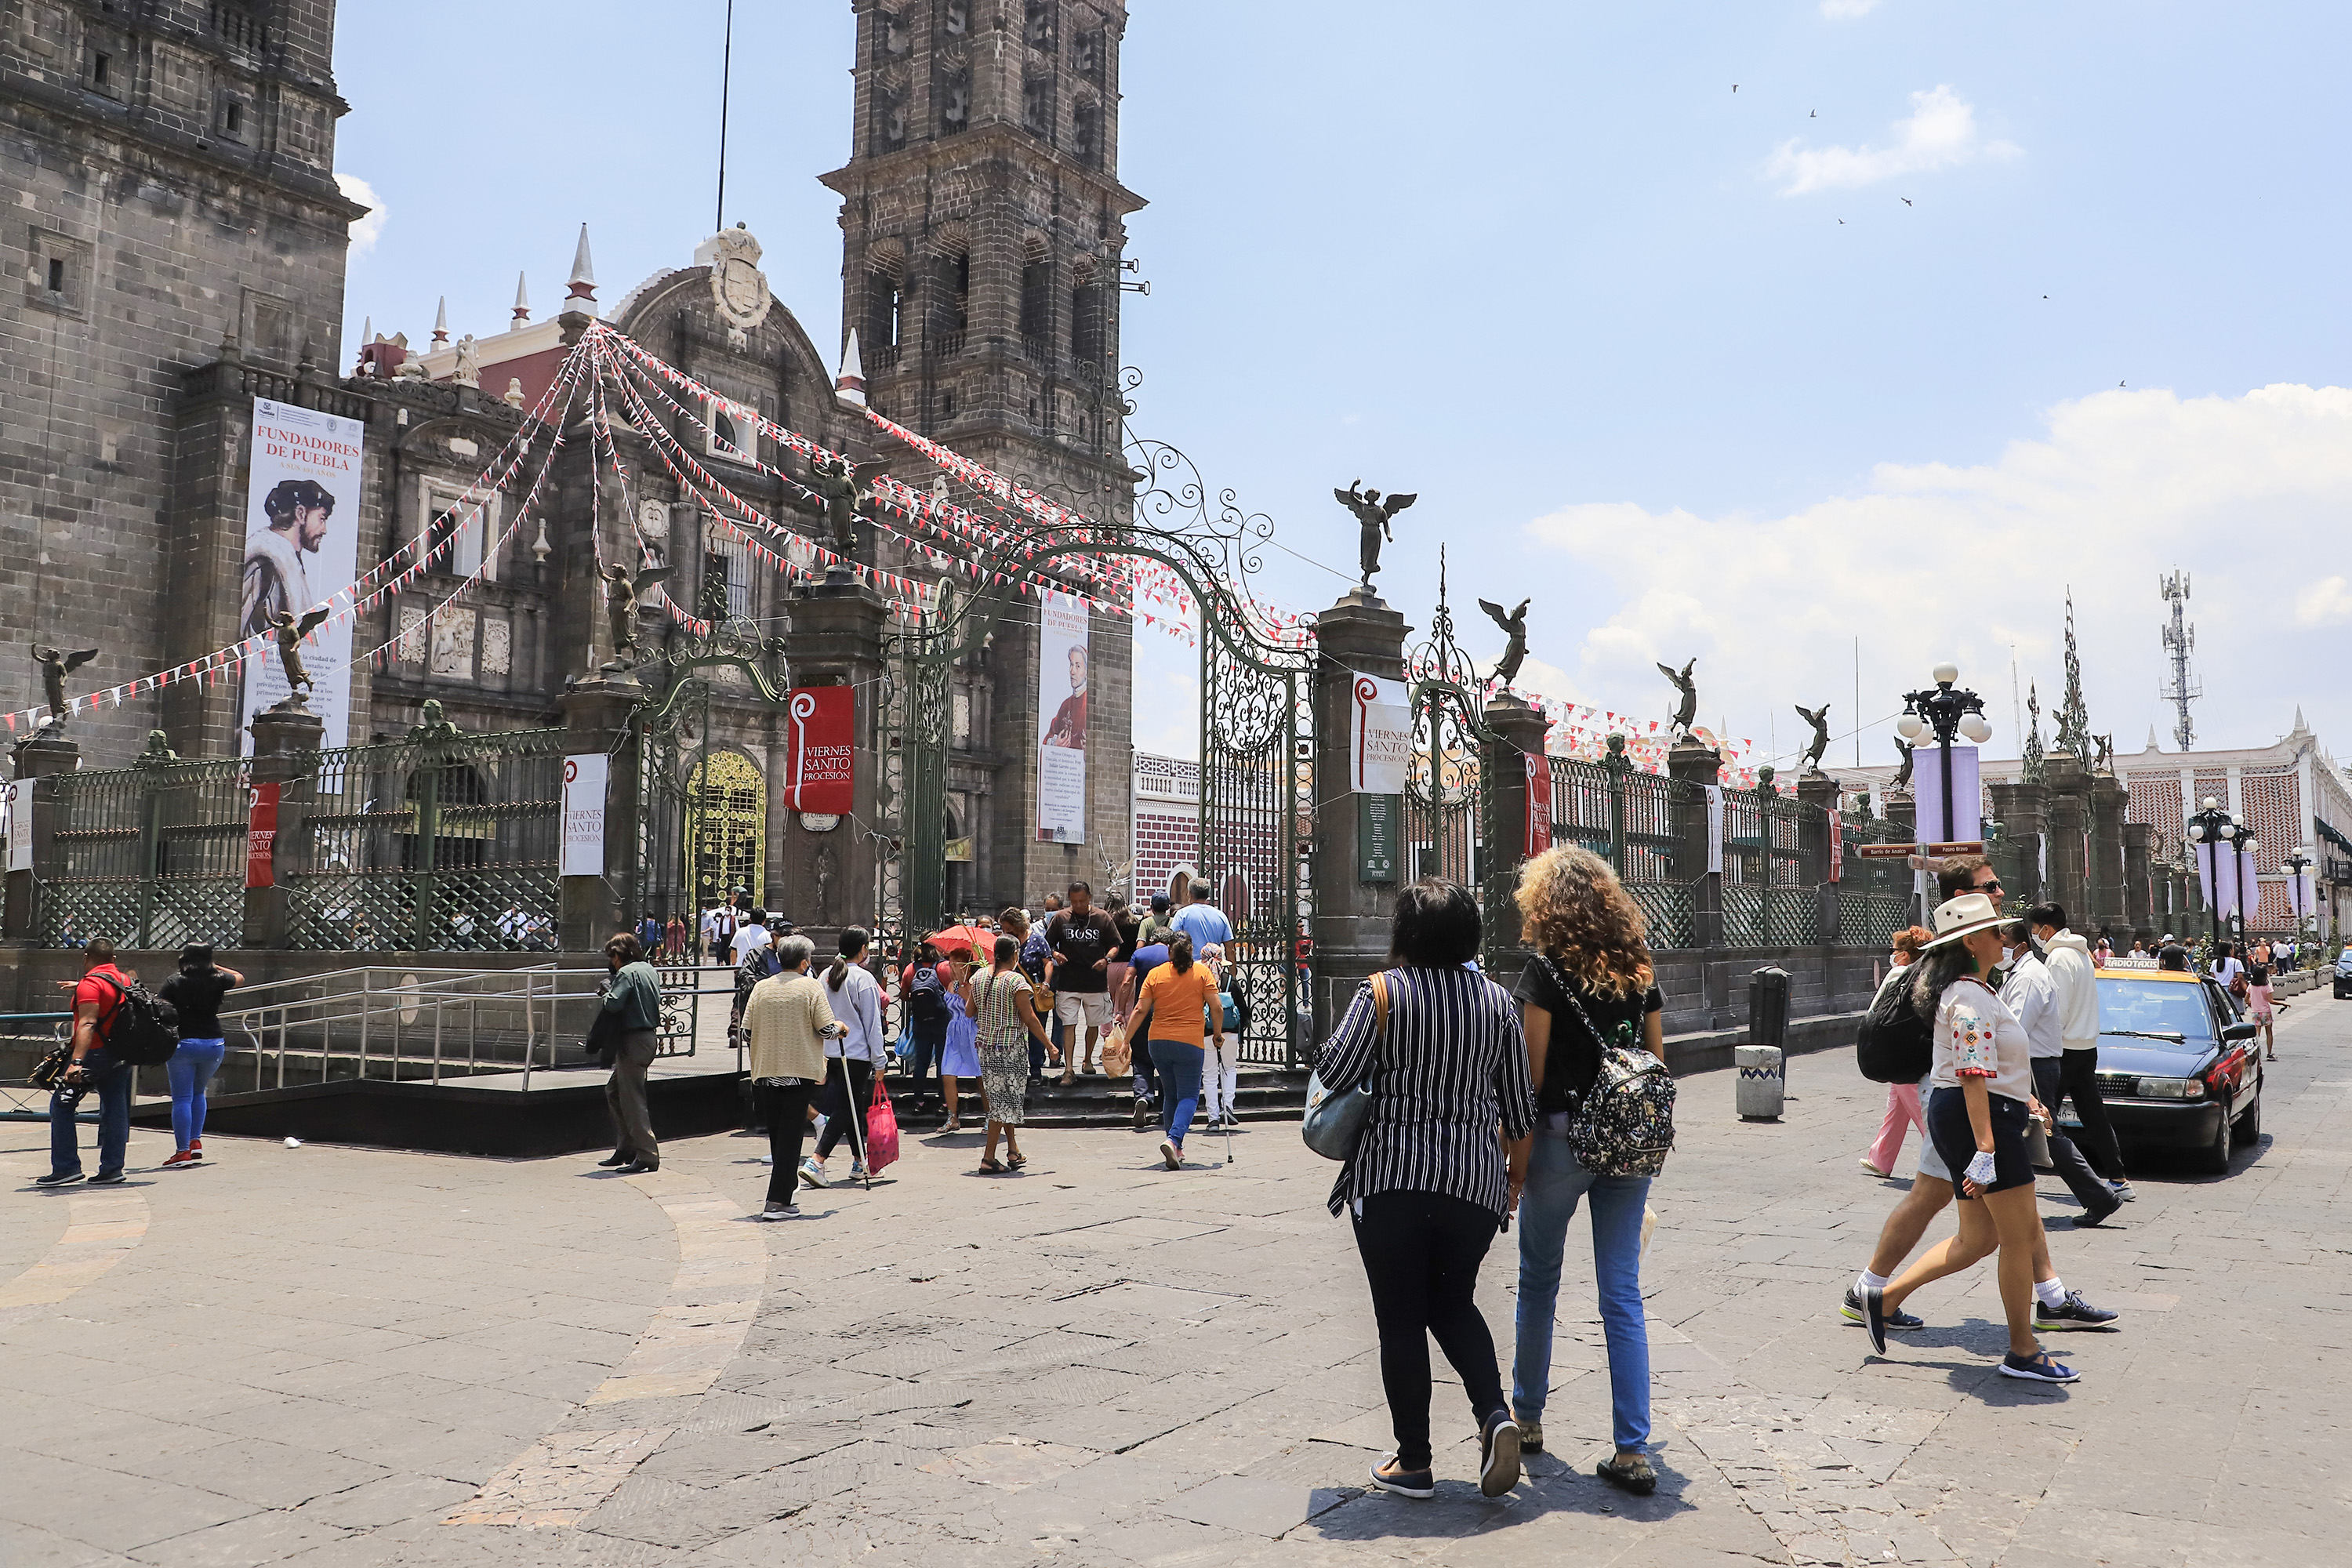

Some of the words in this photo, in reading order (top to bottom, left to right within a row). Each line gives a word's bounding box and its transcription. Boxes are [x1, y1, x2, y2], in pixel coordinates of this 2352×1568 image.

[257, 426, 359, 457] FUNDADORES
[266, 443, 288, 458] DE
[292, 448, 350, 470] PUEBLA
[315, 468, 336, 477] AÑOS
[1044, 608, 1087, 624] FUNDADORES
[256, 681, 287, 690] privilegios
[1368, 728, 1409, 741] VIERNES
[807, 746, 851, 757] VIERNES
[1367, 741, 1408, 753] SANTO
[1367, 753, 1406, 763] PROCESIÓN
[805, 757, 851, 771] SANTO
[804, 771, 851, 781] PROCESIÓN
[569, 810, 601, 819] VIERNES
[568, 822, 601, 833] SANTO
[249, 840, 270, 851] SANTO
[1066, 928, 1099, 939] BOSS
[2105, 959, 2158, 968] RADIOTAXIS
